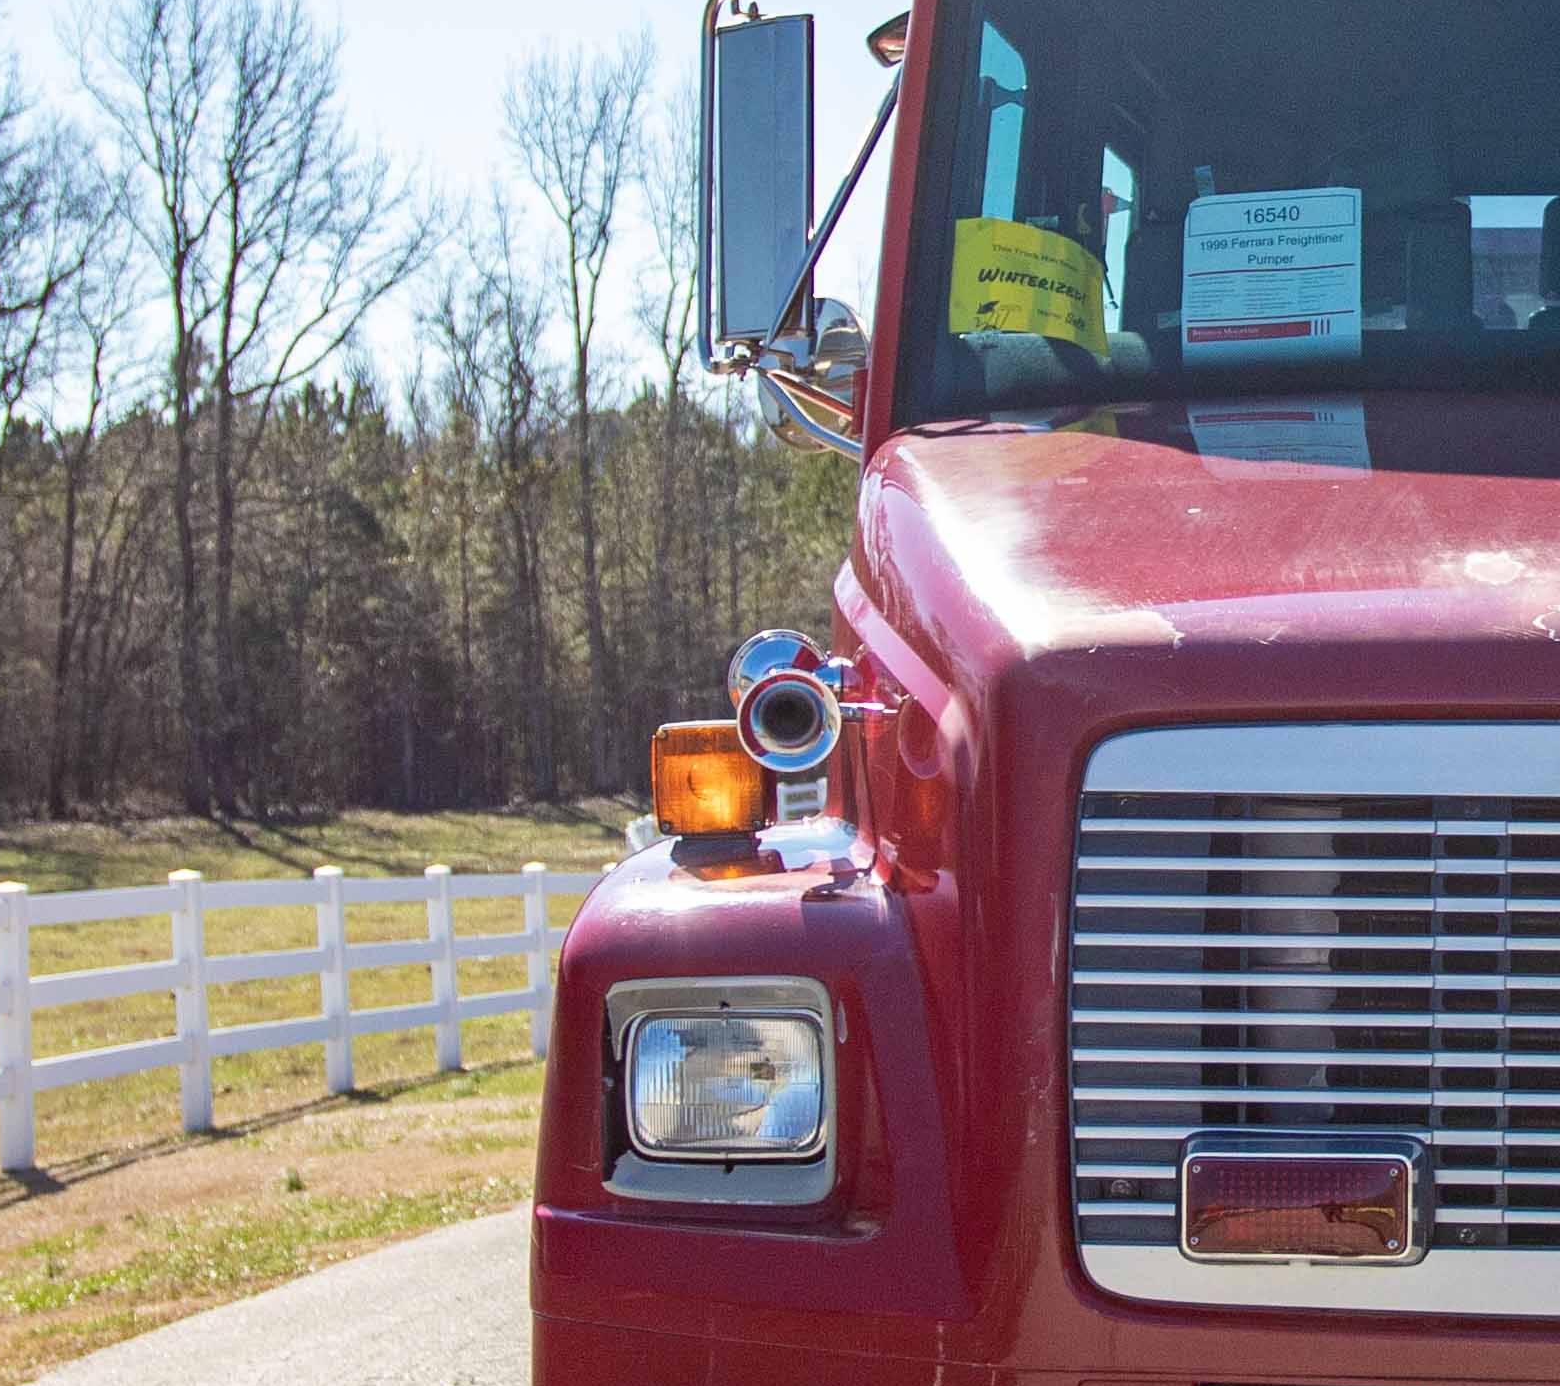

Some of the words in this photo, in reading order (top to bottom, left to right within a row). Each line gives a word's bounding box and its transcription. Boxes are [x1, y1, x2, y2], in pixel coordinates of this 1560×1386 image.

[1243, 205, 1300, 224] 16540
[1200, 239, 1228, 251] 1999
[1231, 237, 1274, 249] Ferrara
[1277, 233, 1344, 248] Freightliner
[1247, 253, 1295, 266] Pumper
